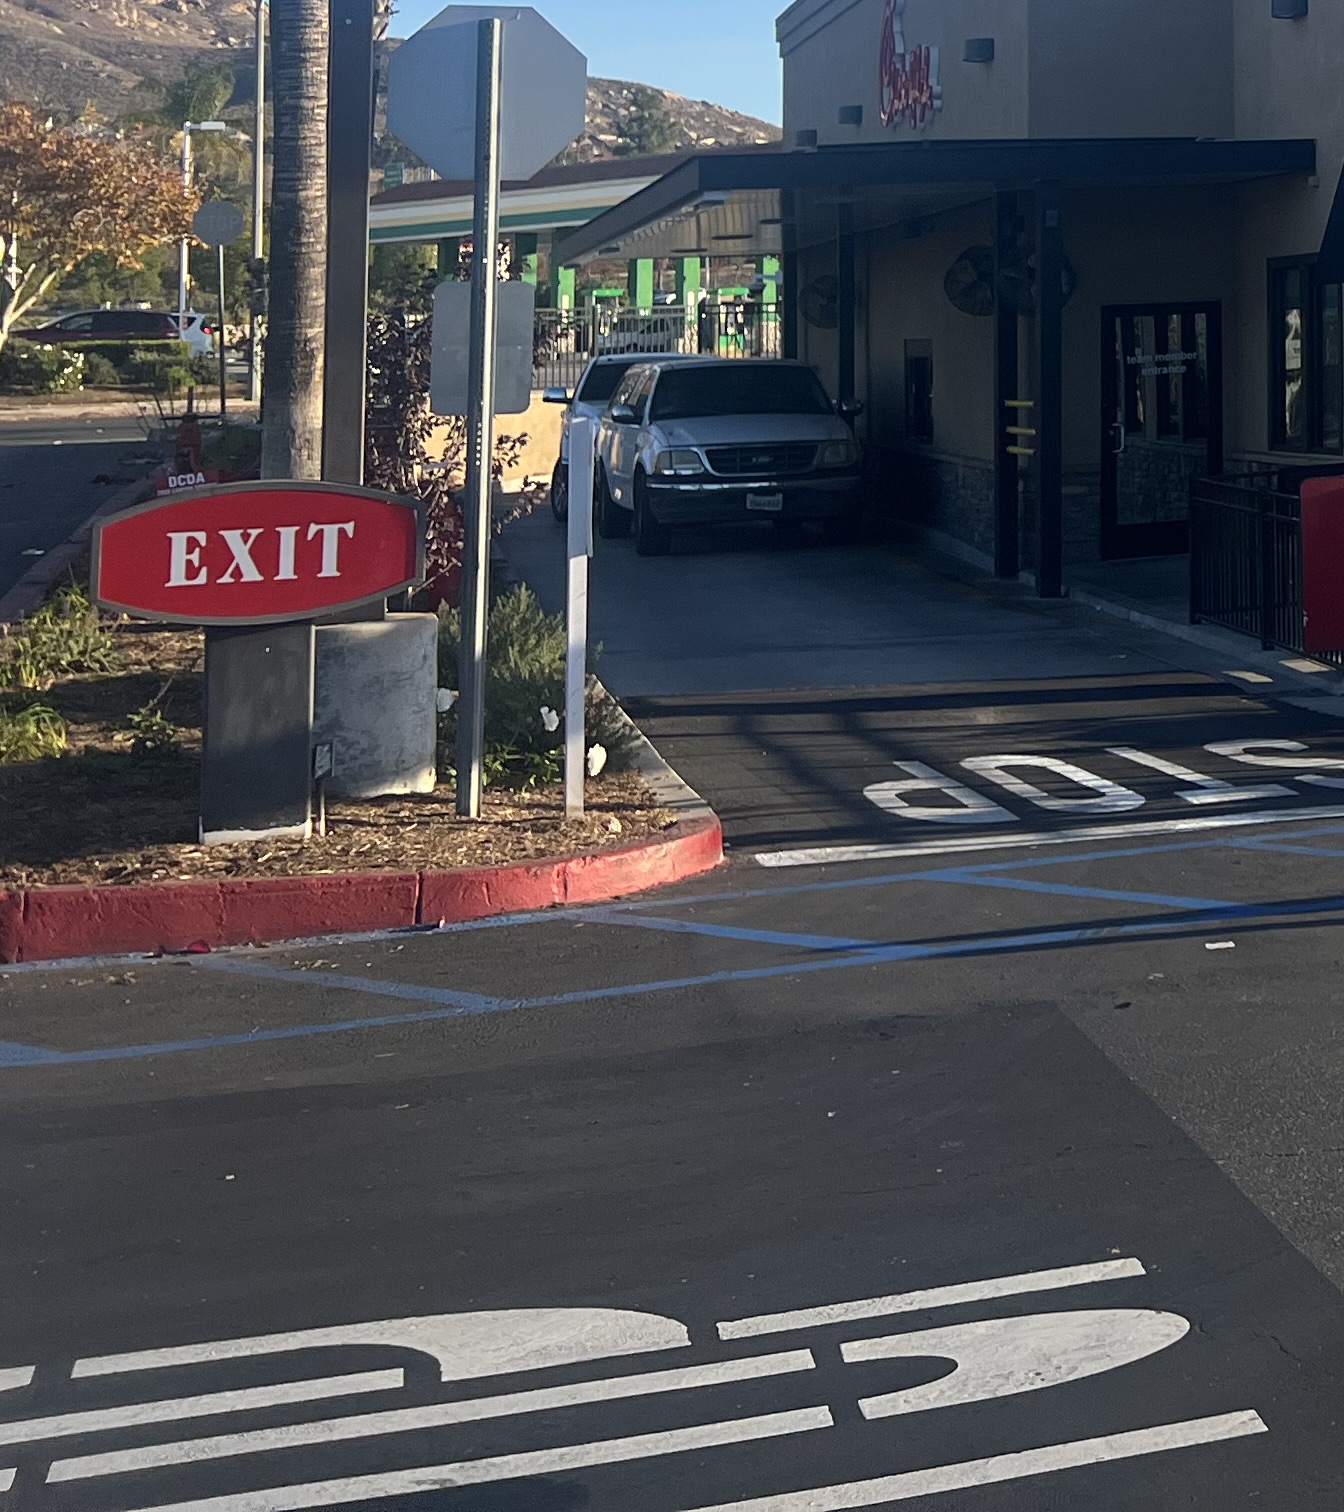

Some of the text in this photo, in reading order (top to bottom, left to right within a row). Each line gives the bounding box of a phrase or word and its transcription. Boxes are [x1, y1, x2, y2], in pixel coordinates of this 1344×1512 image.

[1155, 350, 1198, 362] member
[1141, 365, 1187, 376] entrance
[168, 472, 206, 488] DCDA
[164, 520, 356, 588] EXIT
